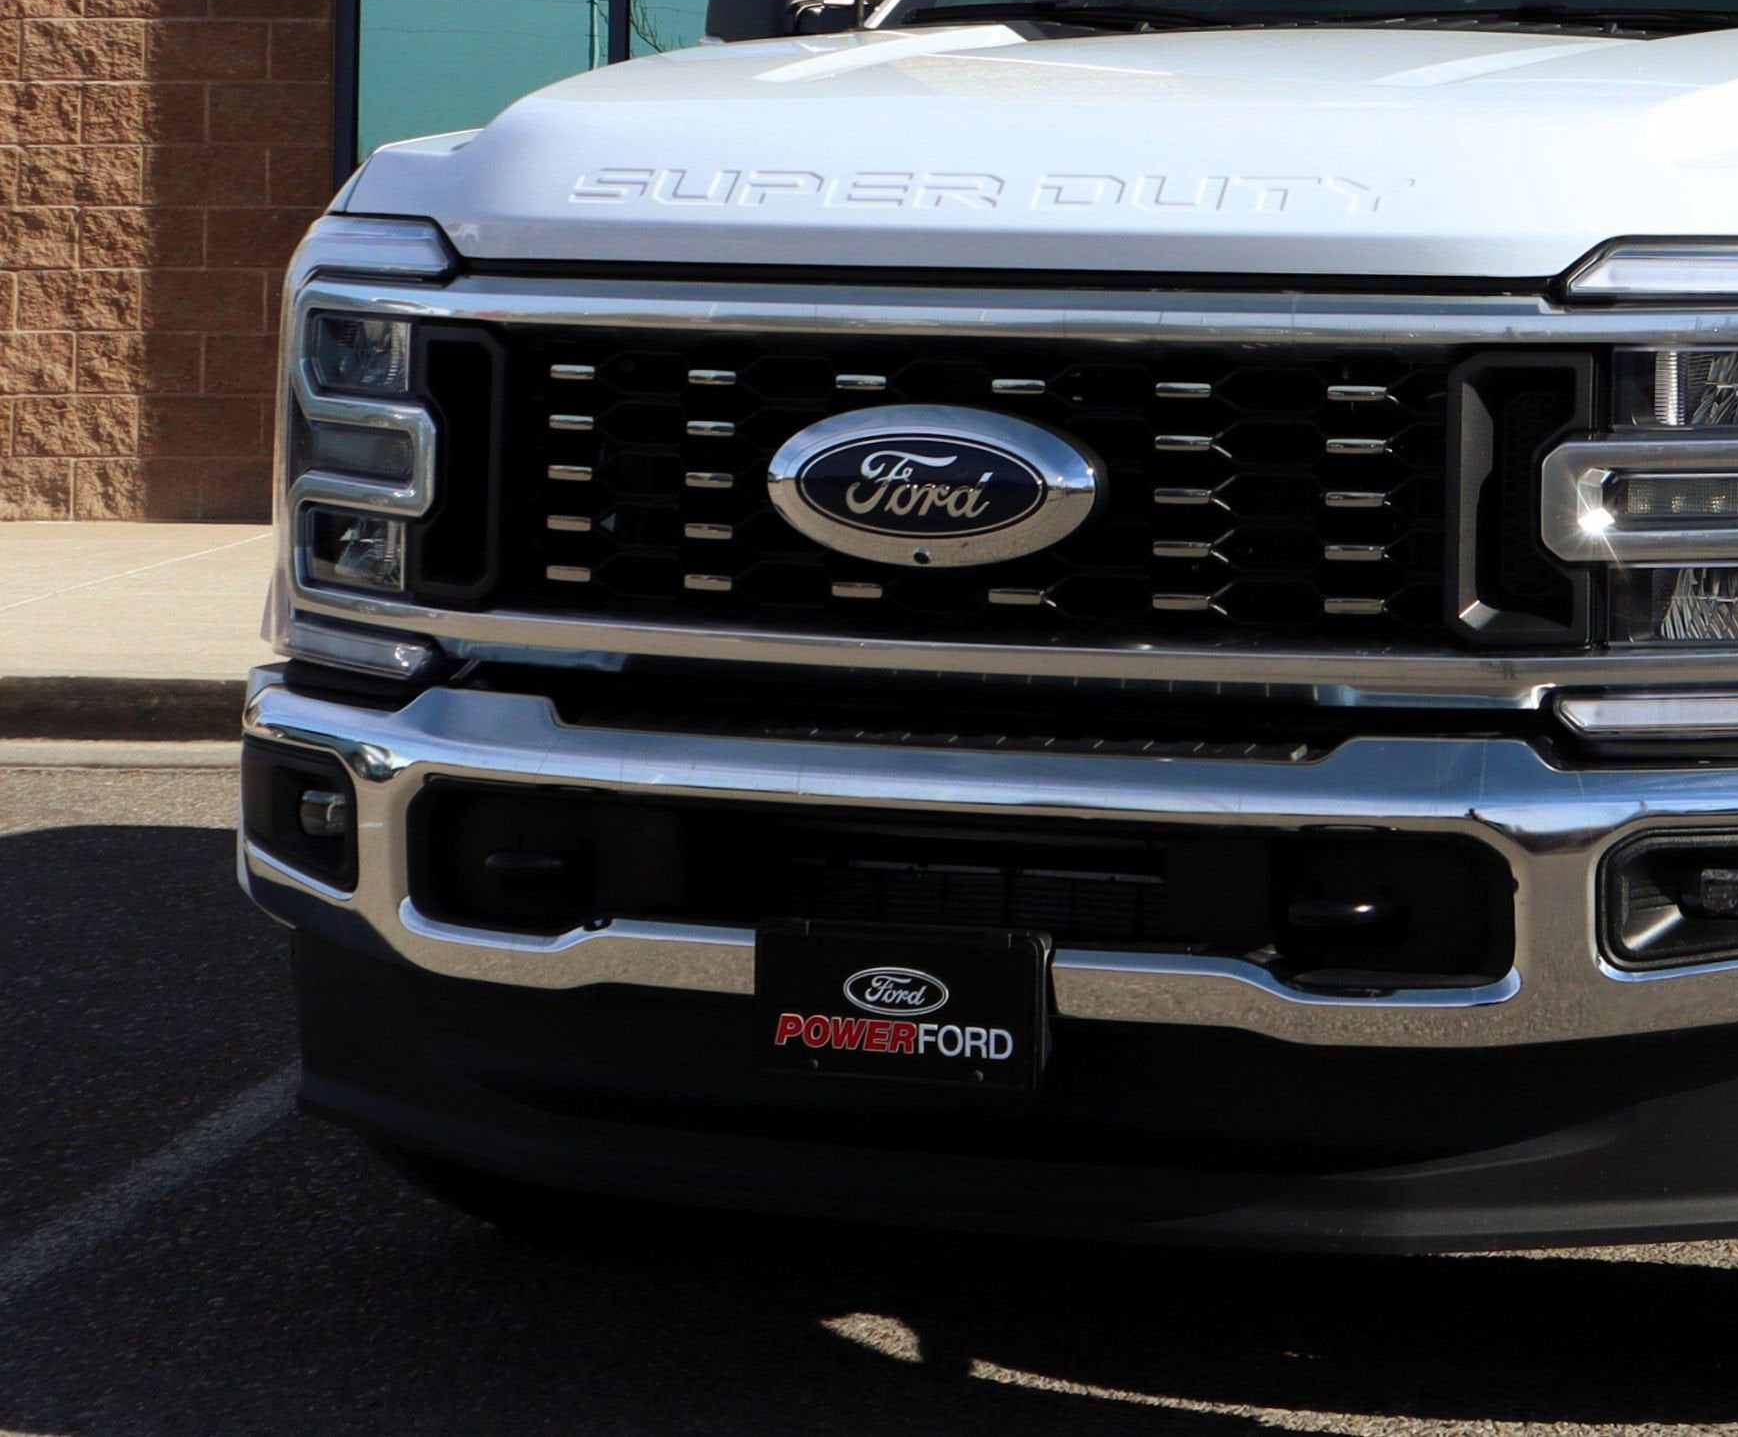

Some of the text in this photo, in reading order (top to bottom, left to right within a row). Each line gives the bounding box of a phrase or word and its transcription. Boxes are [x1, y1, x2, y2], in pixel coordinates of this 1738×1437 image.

[568, 167, 1416, 213] SUPER DUTY
[846, 450, 991, 519] Ford
[865, 975, 926, 1006] Ford
